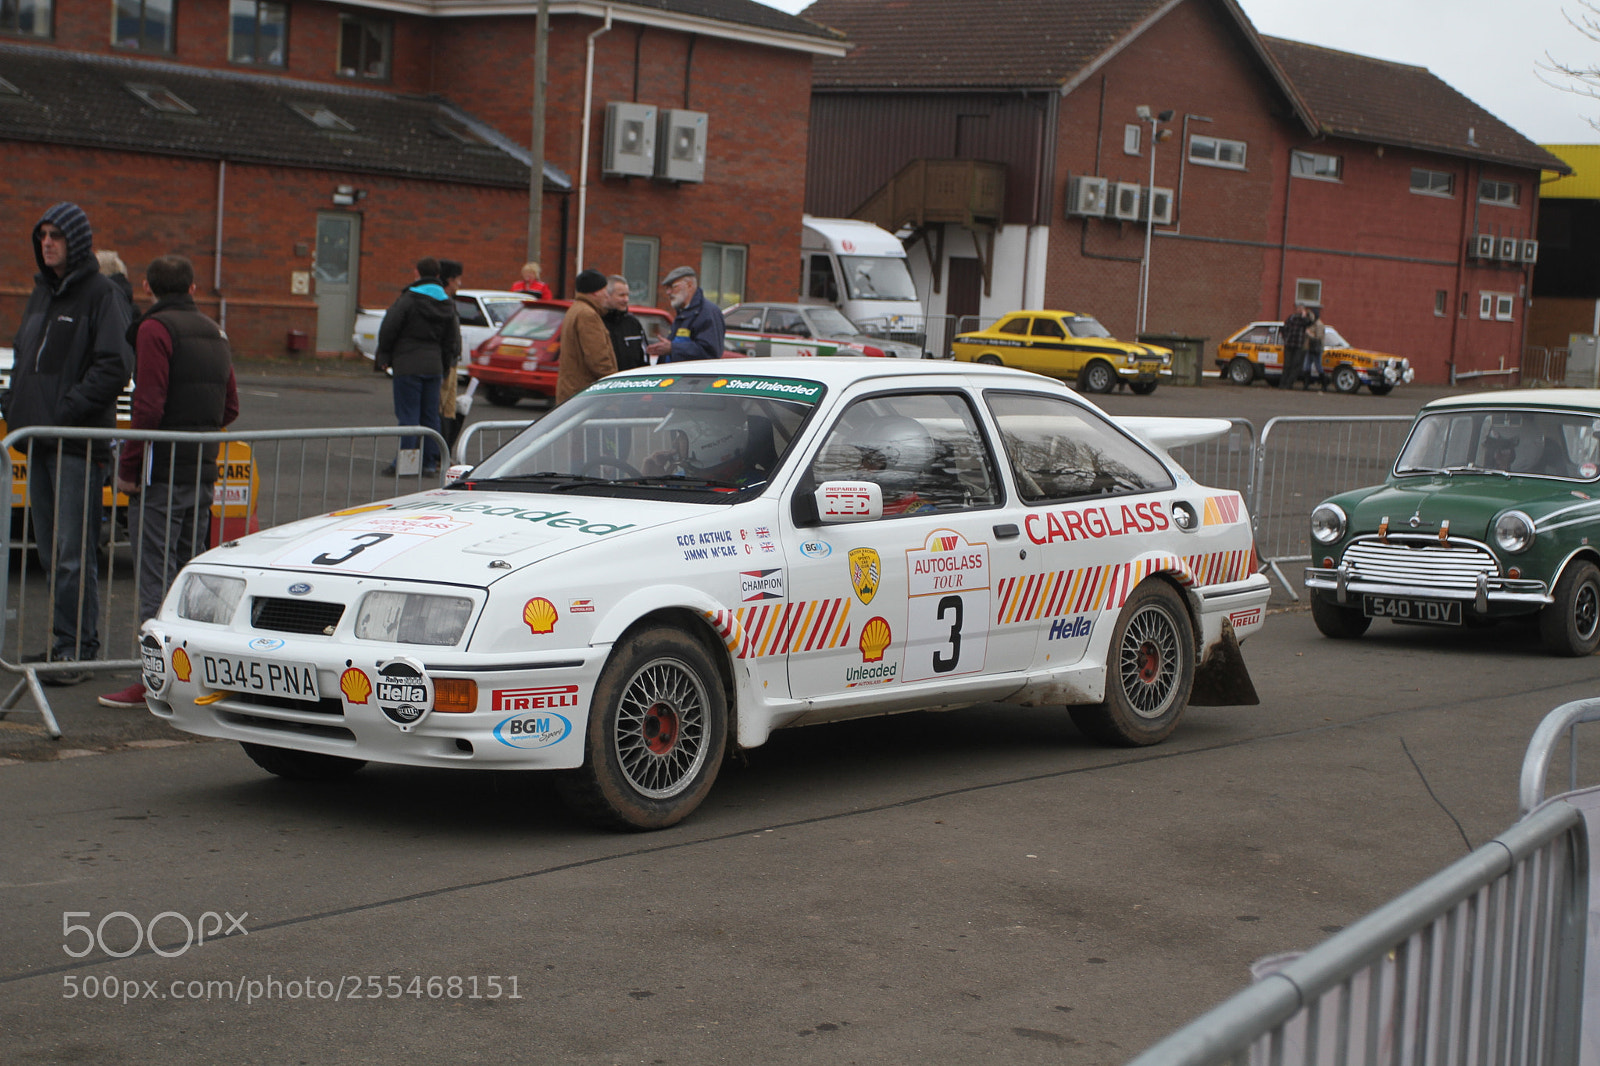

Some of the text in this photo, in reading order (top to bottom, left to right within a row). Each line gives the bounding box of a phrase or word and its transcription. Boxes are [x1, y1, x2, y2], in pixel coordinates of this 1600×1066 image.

[609, 379, 662, 389] Unleaded
[726, 380, 819, 396] Shell Unleaded
[825, 494, 870, 515] RED
[386, 501, 637, 536] Unleaded
[1024, 501, 1169, 545] CARGLASS
[677, 534, 696, 547] ROB
[699, 530, 732, 545] ARTHUR
[805, 543, 823, 552] BGM
[311, 532, 393, 566] 3
[684, 548, 708, 561] JIMMY
[914, 554, 983, 575] AUTOGLASS
[742, 578, 782, 592] CHAMPION
[933, 574, 963, 589] TOUR
[1229, 607, 1261, 628] PIRELLI
[1373, 597, 1453, 621] 540 TDV
[932, 595, 964, 673] 3
[1048, 616, 1092, 641] Hella
[846, 661, 897, 681] Unleaded
[379, 684, 424, 702] Hella
[491, 684, 579, 711] PIRELLI
[510, 718, 550, 735] BGM
